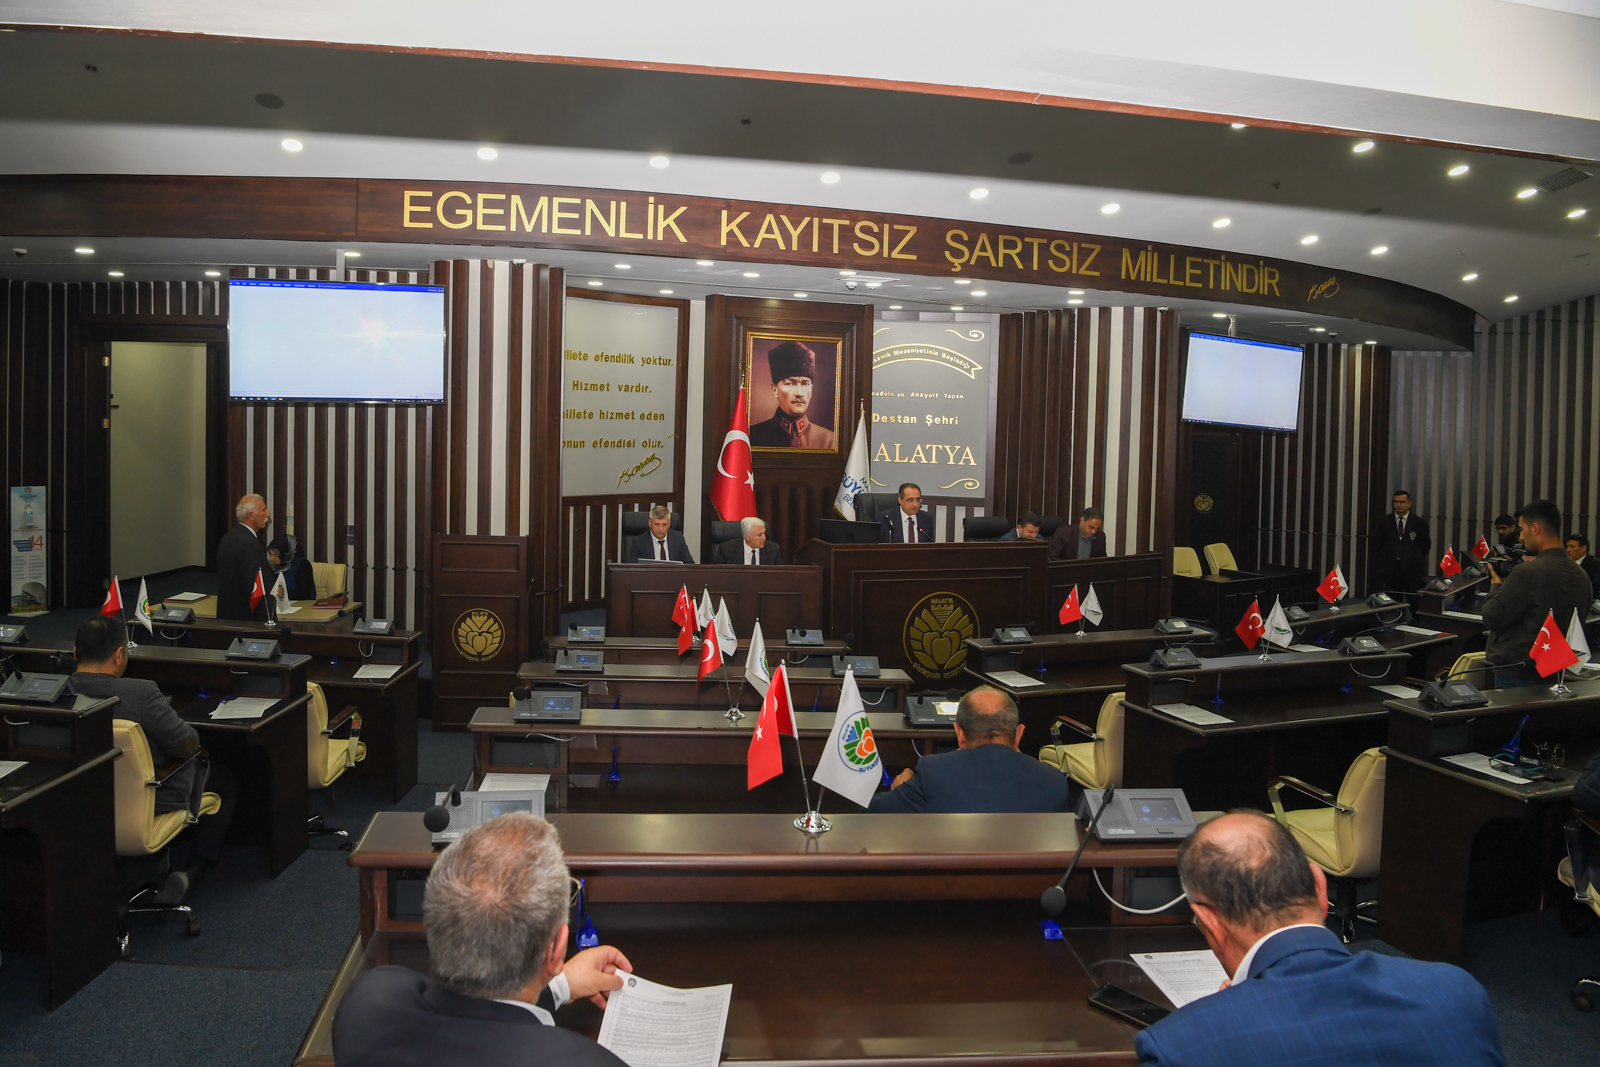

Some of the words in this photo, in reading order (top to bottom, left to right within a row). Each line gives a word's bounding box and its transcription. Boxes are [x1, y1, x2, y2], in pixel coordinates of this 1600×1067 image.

[403, 190, 688, 243] EGEMENLİK
[720, 208, 917, 261] KAYITSIZ
[944, 229, 1101, 277] ŞARTSIZ
[1120, 244, 1280, 298] MİLLETİNDİR
[564, 350, 589, 361] illete
[594, 352, 635, 364] efendilik
[641, 355, 674, 366] yoktur.
[572, 380, 611, 392] Hizmet
[618, 383, 652, 393] vardır.
[563, 408, 594, 419] illete
[599, 409, 635, 420] hizmet
[640, 411, 665, 421] eden
[872, 413, 917, 424] Destan
[925, 414, 959, 427] Şehri
[873, 442, 977, 466] ALATYA
[28, 535, 44, 548] 14
